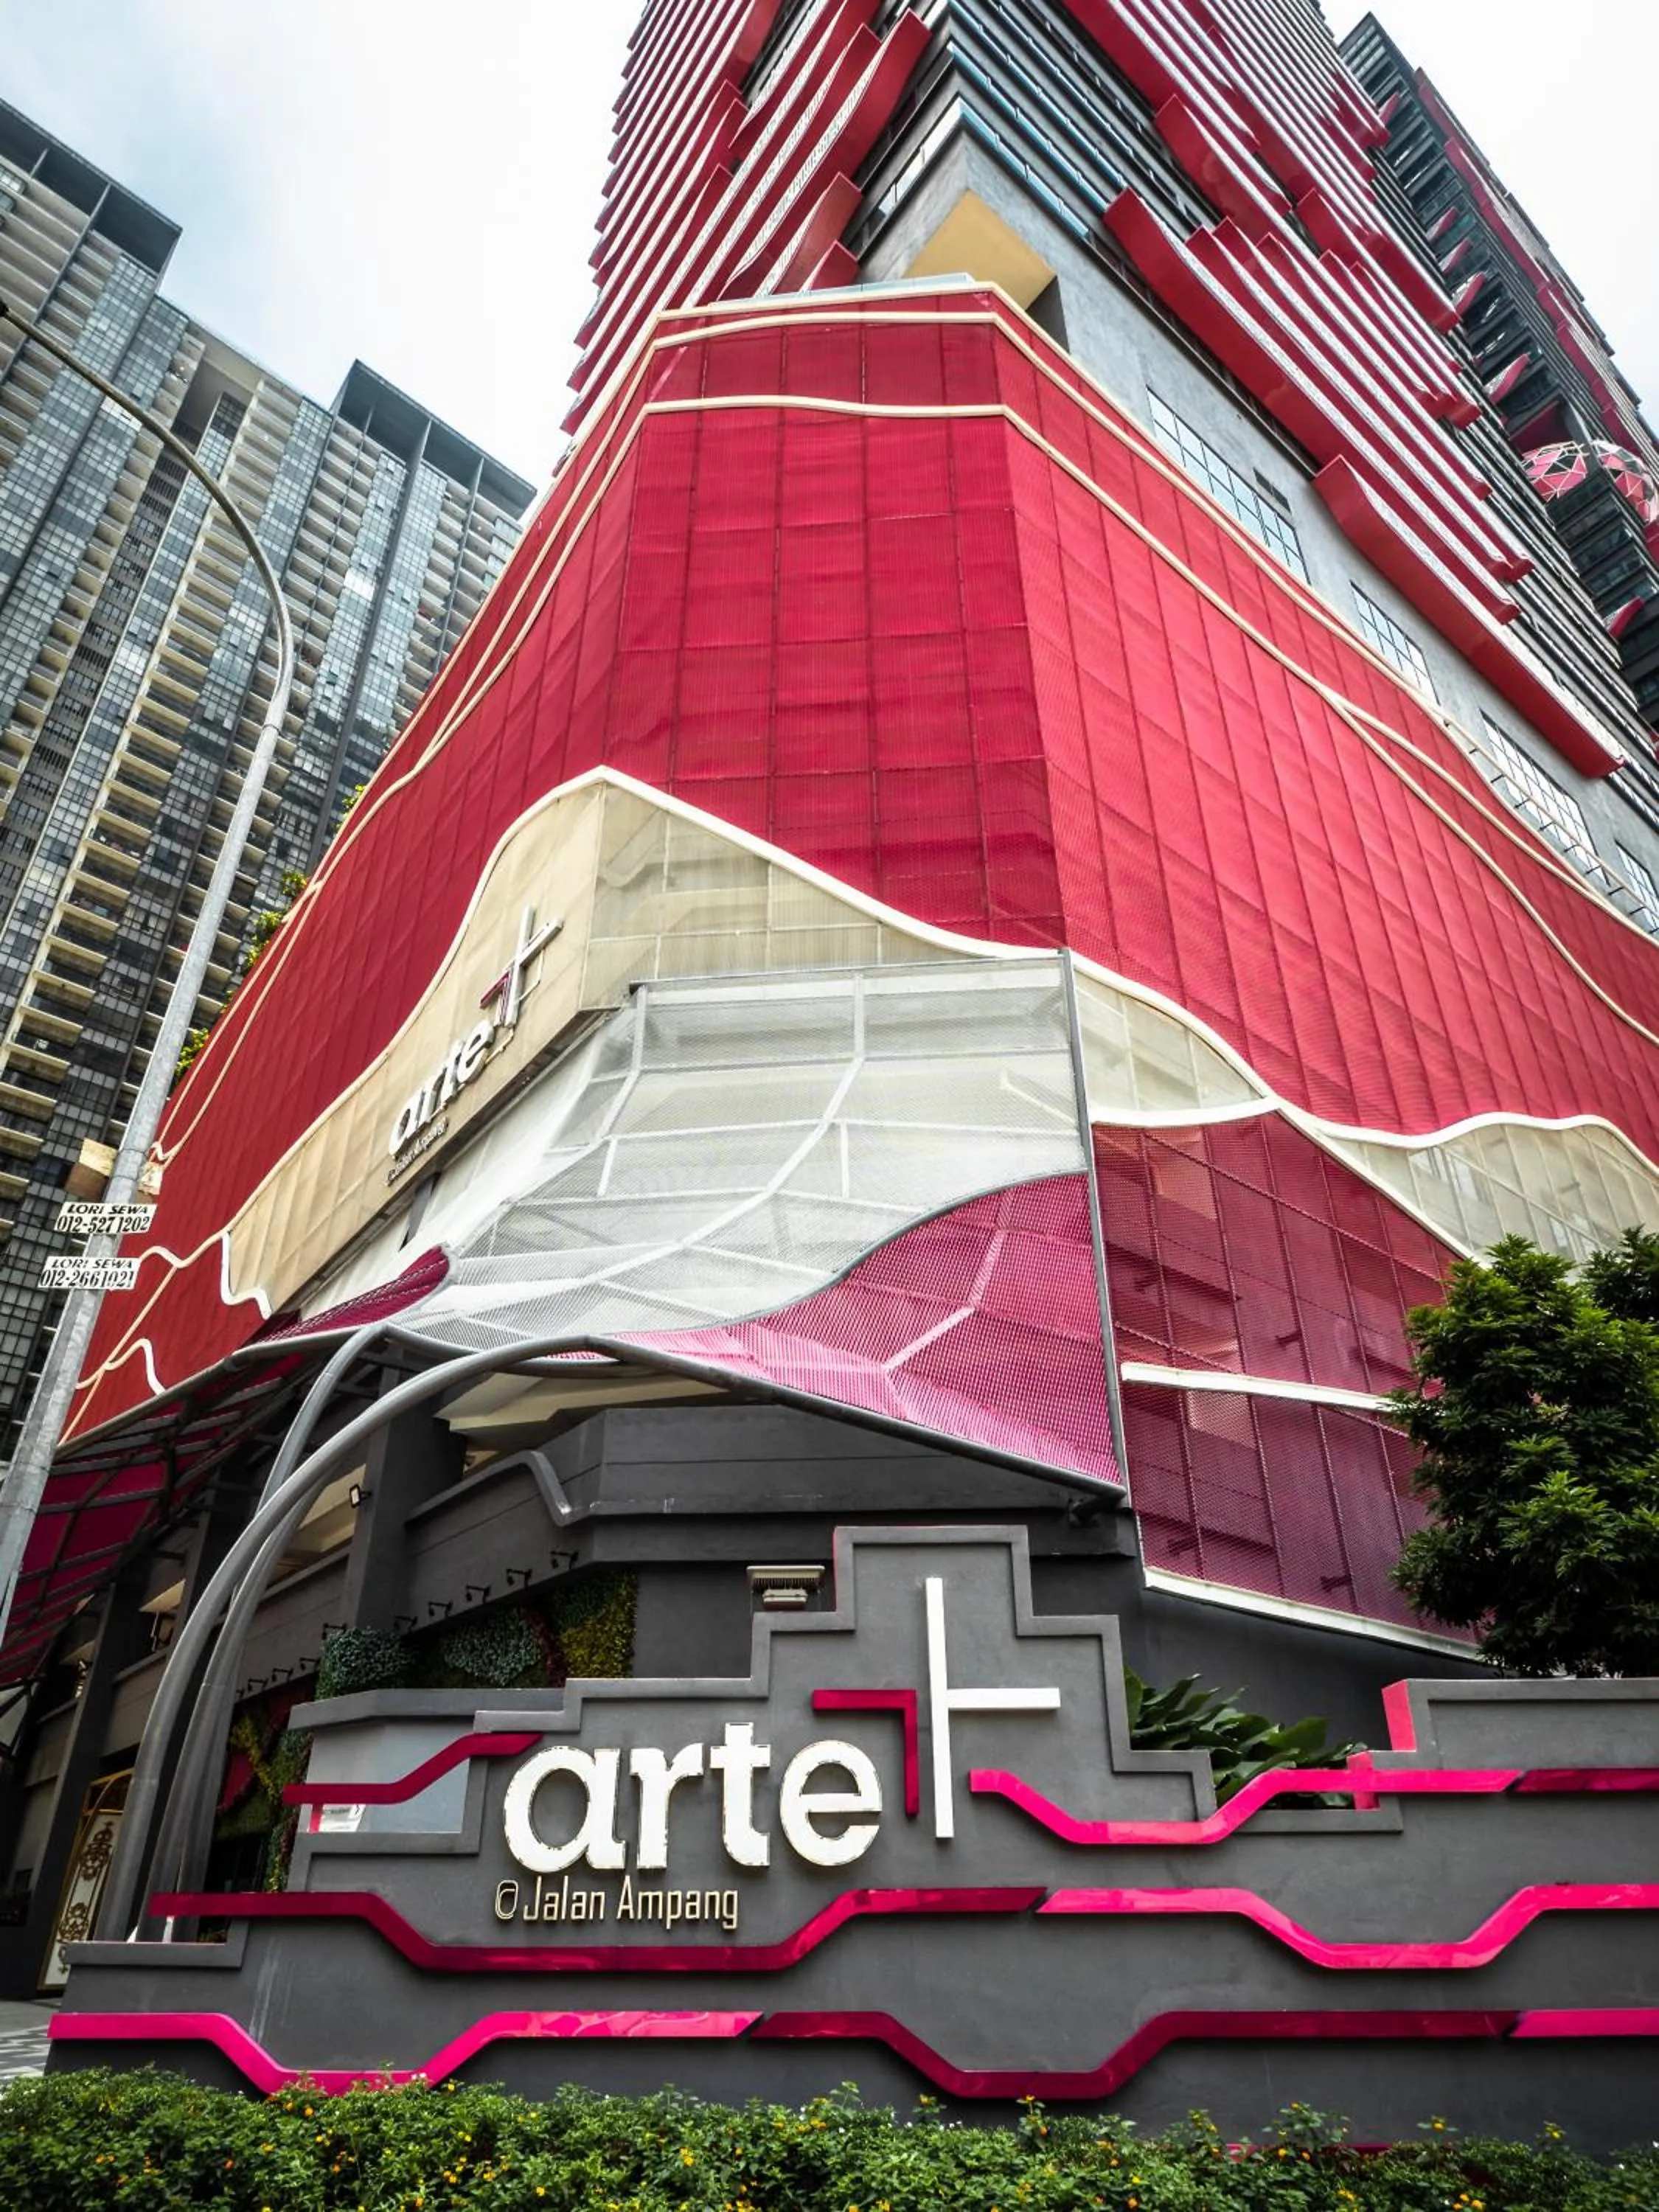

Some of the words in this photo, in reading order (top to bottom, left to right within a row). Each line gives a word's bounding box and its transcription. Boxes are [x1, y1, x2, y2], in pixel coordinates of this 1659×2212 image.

[67, 1204, 104, 1214] LORI
[108, 1205, 147, 1214] SEWA
[52, 1259, 88, 1269] LORI
[93, 1259, 133, 1269] SEWA
[616, 1875, 738, 1930] Ampang
